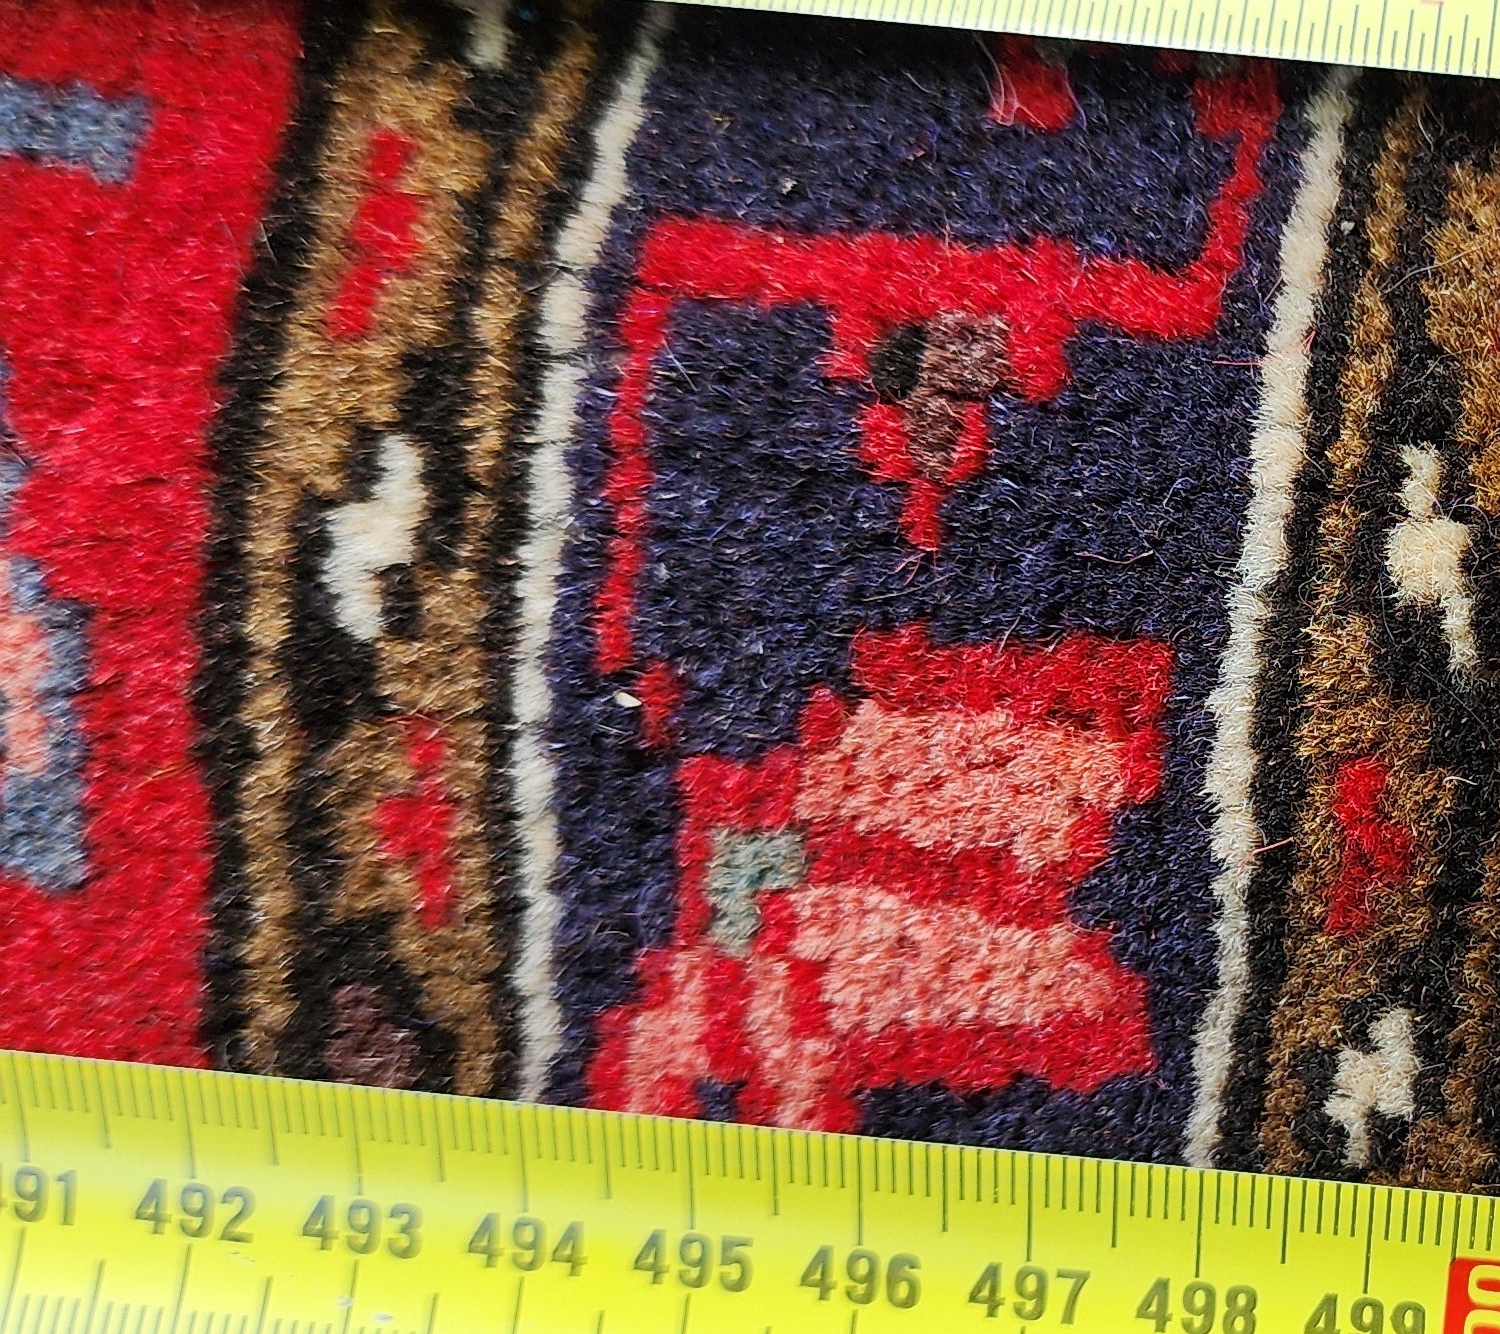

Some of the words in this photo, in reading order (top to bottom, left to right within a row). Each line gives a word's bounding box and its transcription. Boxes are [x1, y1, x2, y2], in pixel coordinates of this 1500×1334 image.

[0, 1165, 78, 1226] 91
[135, 1178, 256, 1244] 492
[301, 1195, 423, 1259] 493
[467, 1212, 588, 1277] 494
[633, 1229, 753, 1292] 495
[800, 1244, 922, 1309] 496
[968, 1262, 1091, 1325] 497
